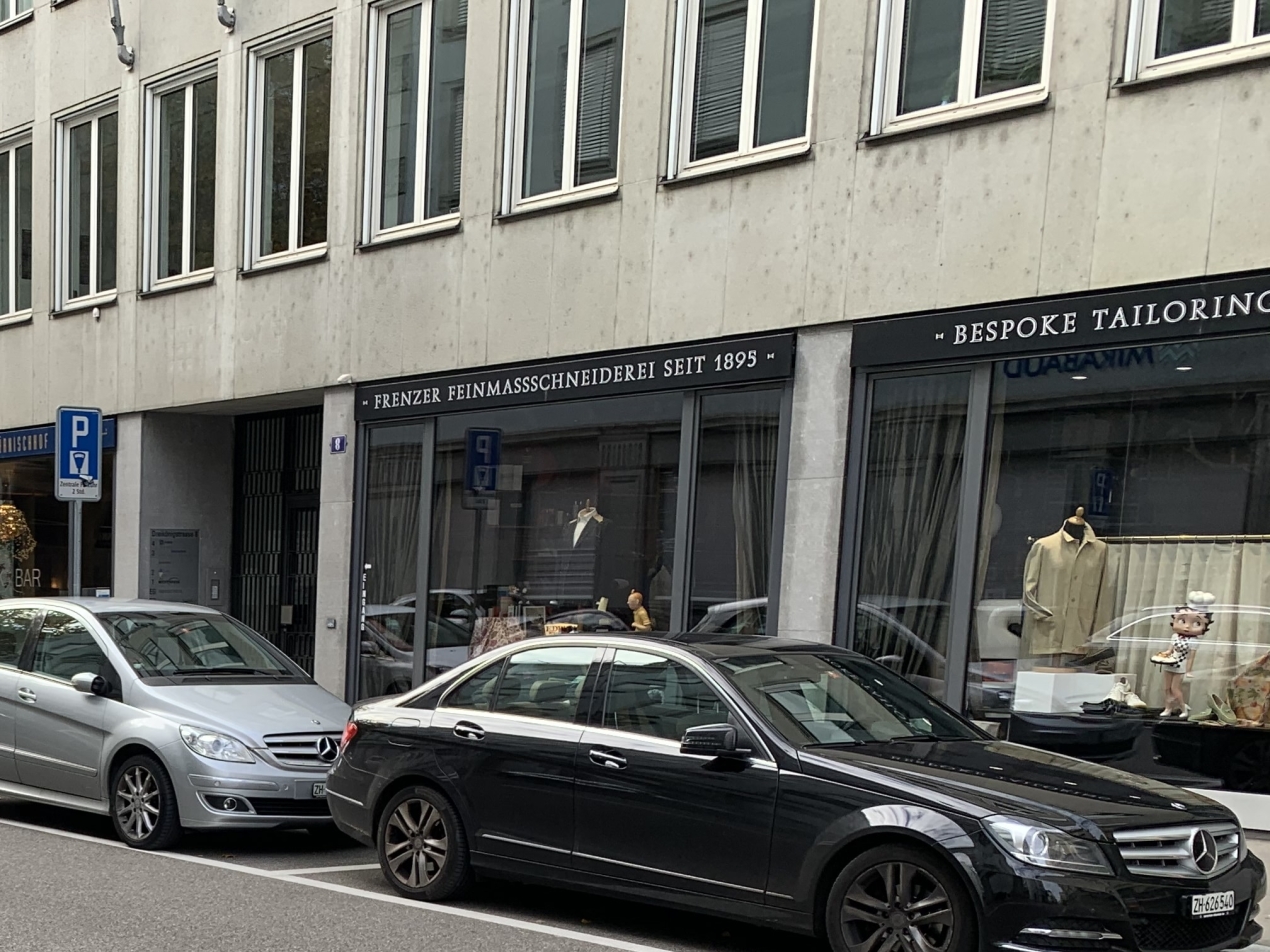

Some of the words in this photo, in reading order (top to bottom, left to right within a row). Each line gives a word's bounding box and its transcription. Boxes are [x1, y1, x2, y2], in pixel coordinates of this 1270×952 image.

[953, 312, 1078, 345] BESPOKE
[374, 387, 441, 410] FRENZER
[448, 362, 656, 402] FEINMASSSCHNEIDEREI
[663, 356, 706, 378] SEIT
[714, 350, 757, 372] 1895
[72, 415, 89, 448] P
[334, 437, 341, 451] 8
[15, 568, 41, 587] BAR
